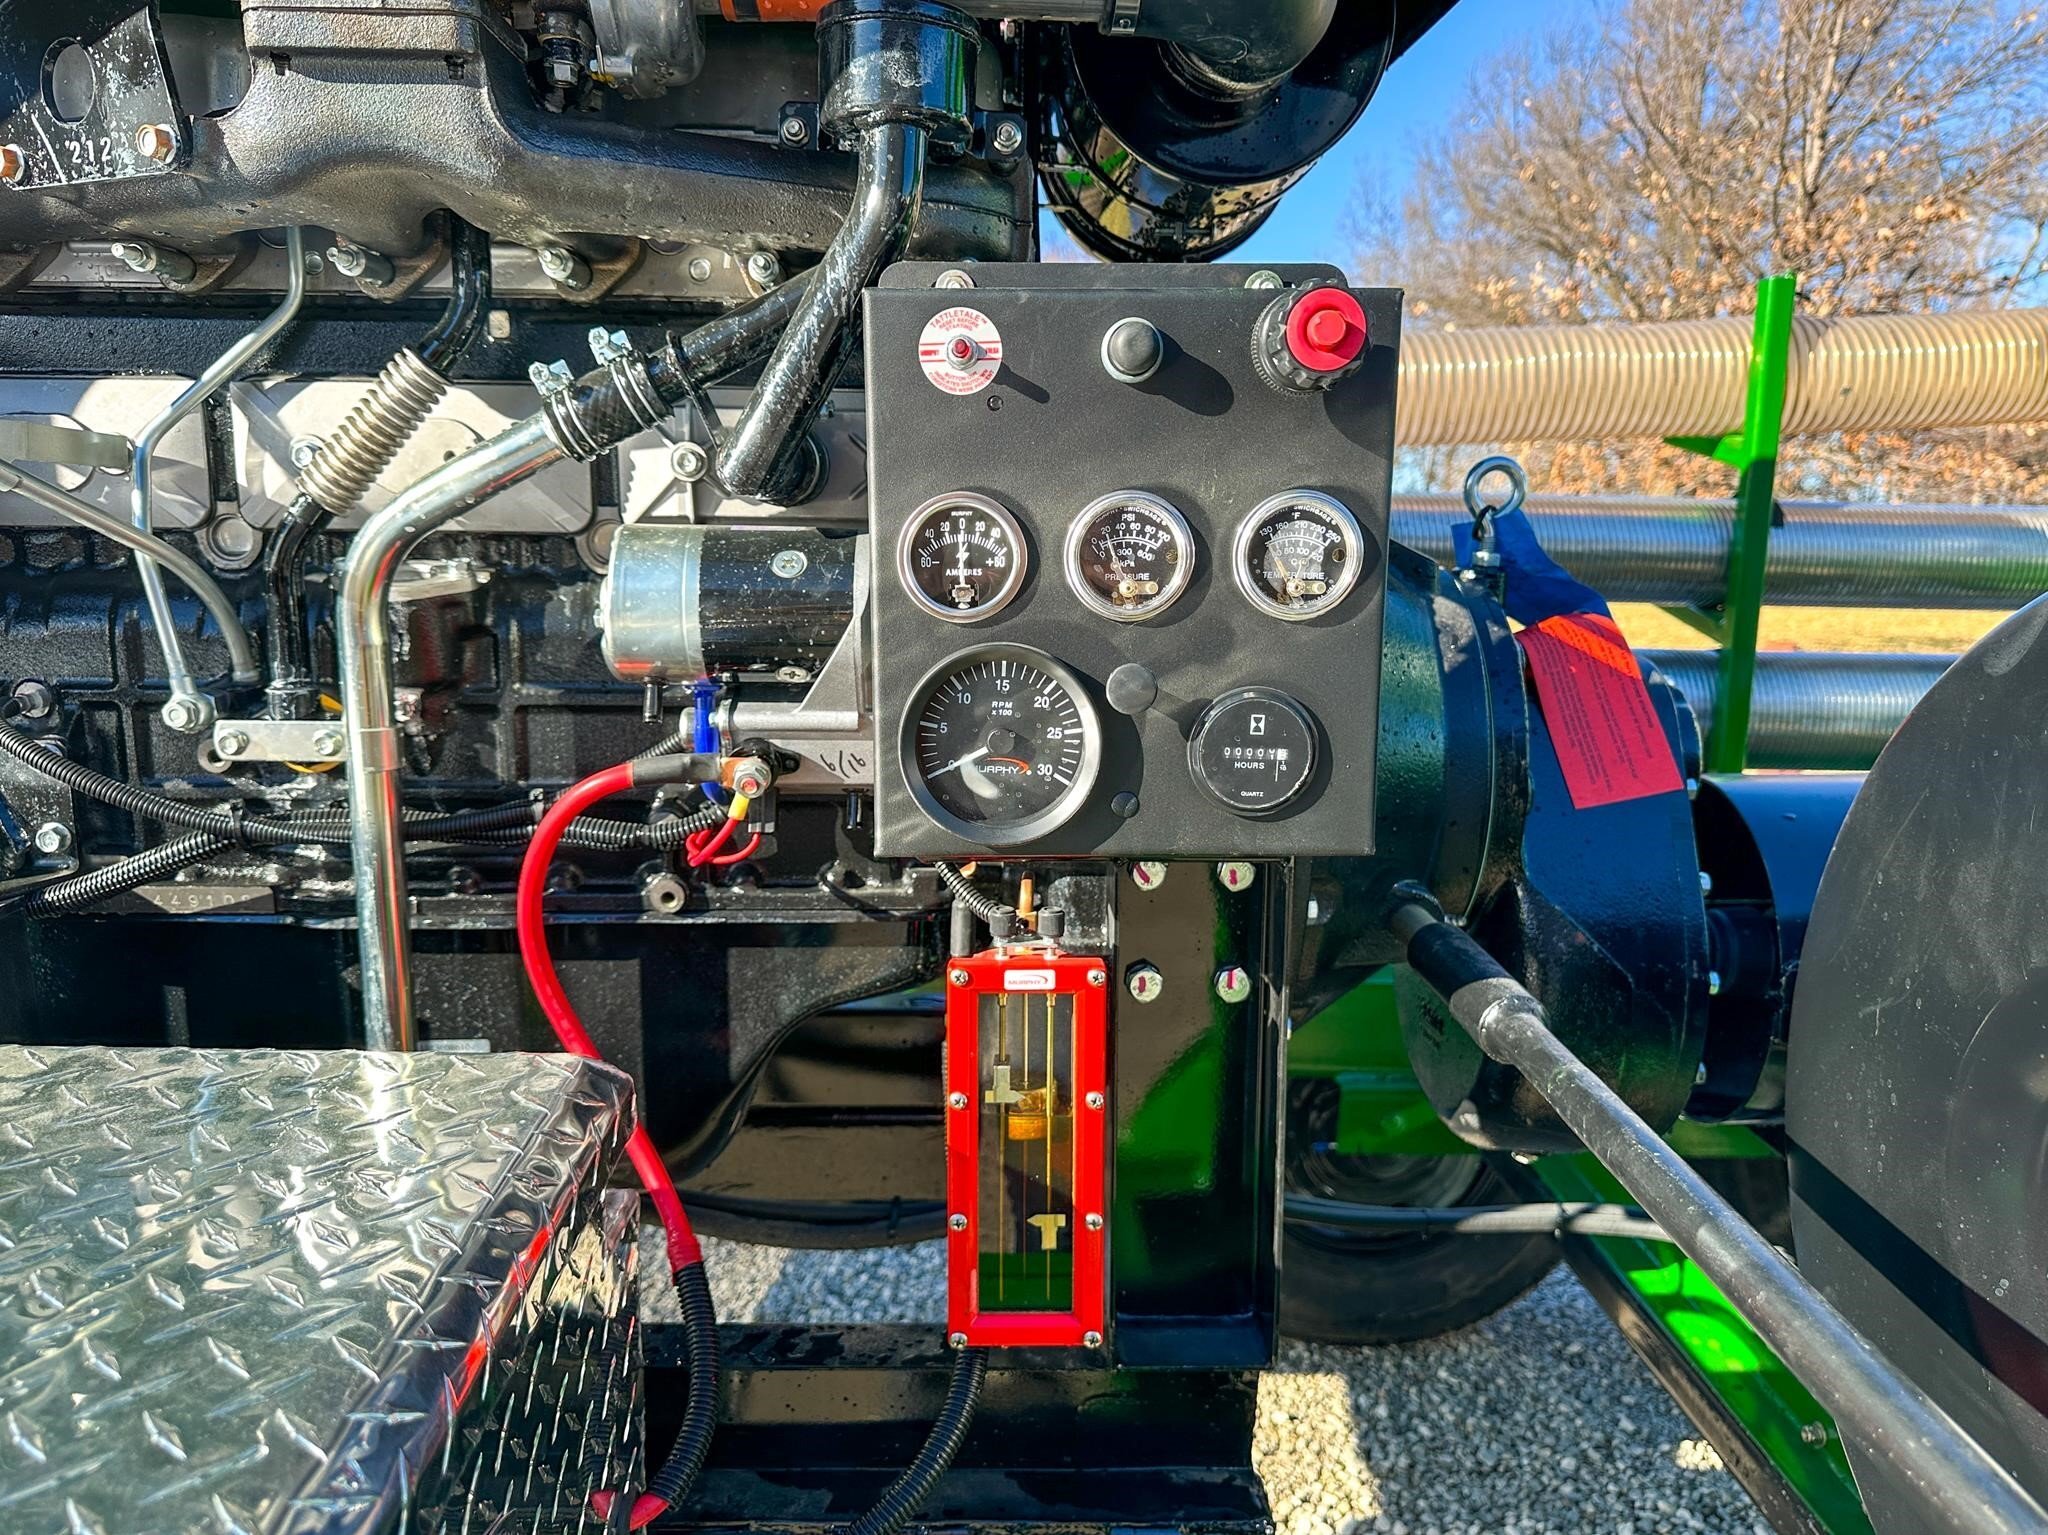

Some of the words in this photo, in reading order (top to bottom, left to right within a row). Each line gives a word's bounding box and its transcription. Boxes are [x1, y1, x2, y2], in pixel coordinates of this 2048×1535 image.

[1121, 513, 1136, 521] PSI
[925, 528, 935, 539] 40
[940, 521, 950, 532] 20
[959, 518, 966, 530] 0
[975, 521, 986, 532] 20
[990, 527, 1001, 538] 40
[1100, 525, 1111, 535] 20
[1115, 522, 1126, 530] 40
[1129, 522, 1141, 531] 60
[1259, 525, 1273, 537] 130
[1116, 548, 1133, 556] 300
[994, 679, 1010, 691] 15
[957, 692, 972, 705] 10
[1033, 696, 1050, 708] 20
[991, 701, 1013, 709] RPM
[940, 722, 948, 734] 5
[1046, 726, 1063, 739] 25
[974, 765, 1020, 774] URPHY
[1036, 763, 1053, 776] 30
[1234, 761, 1265, 769] HOURS
